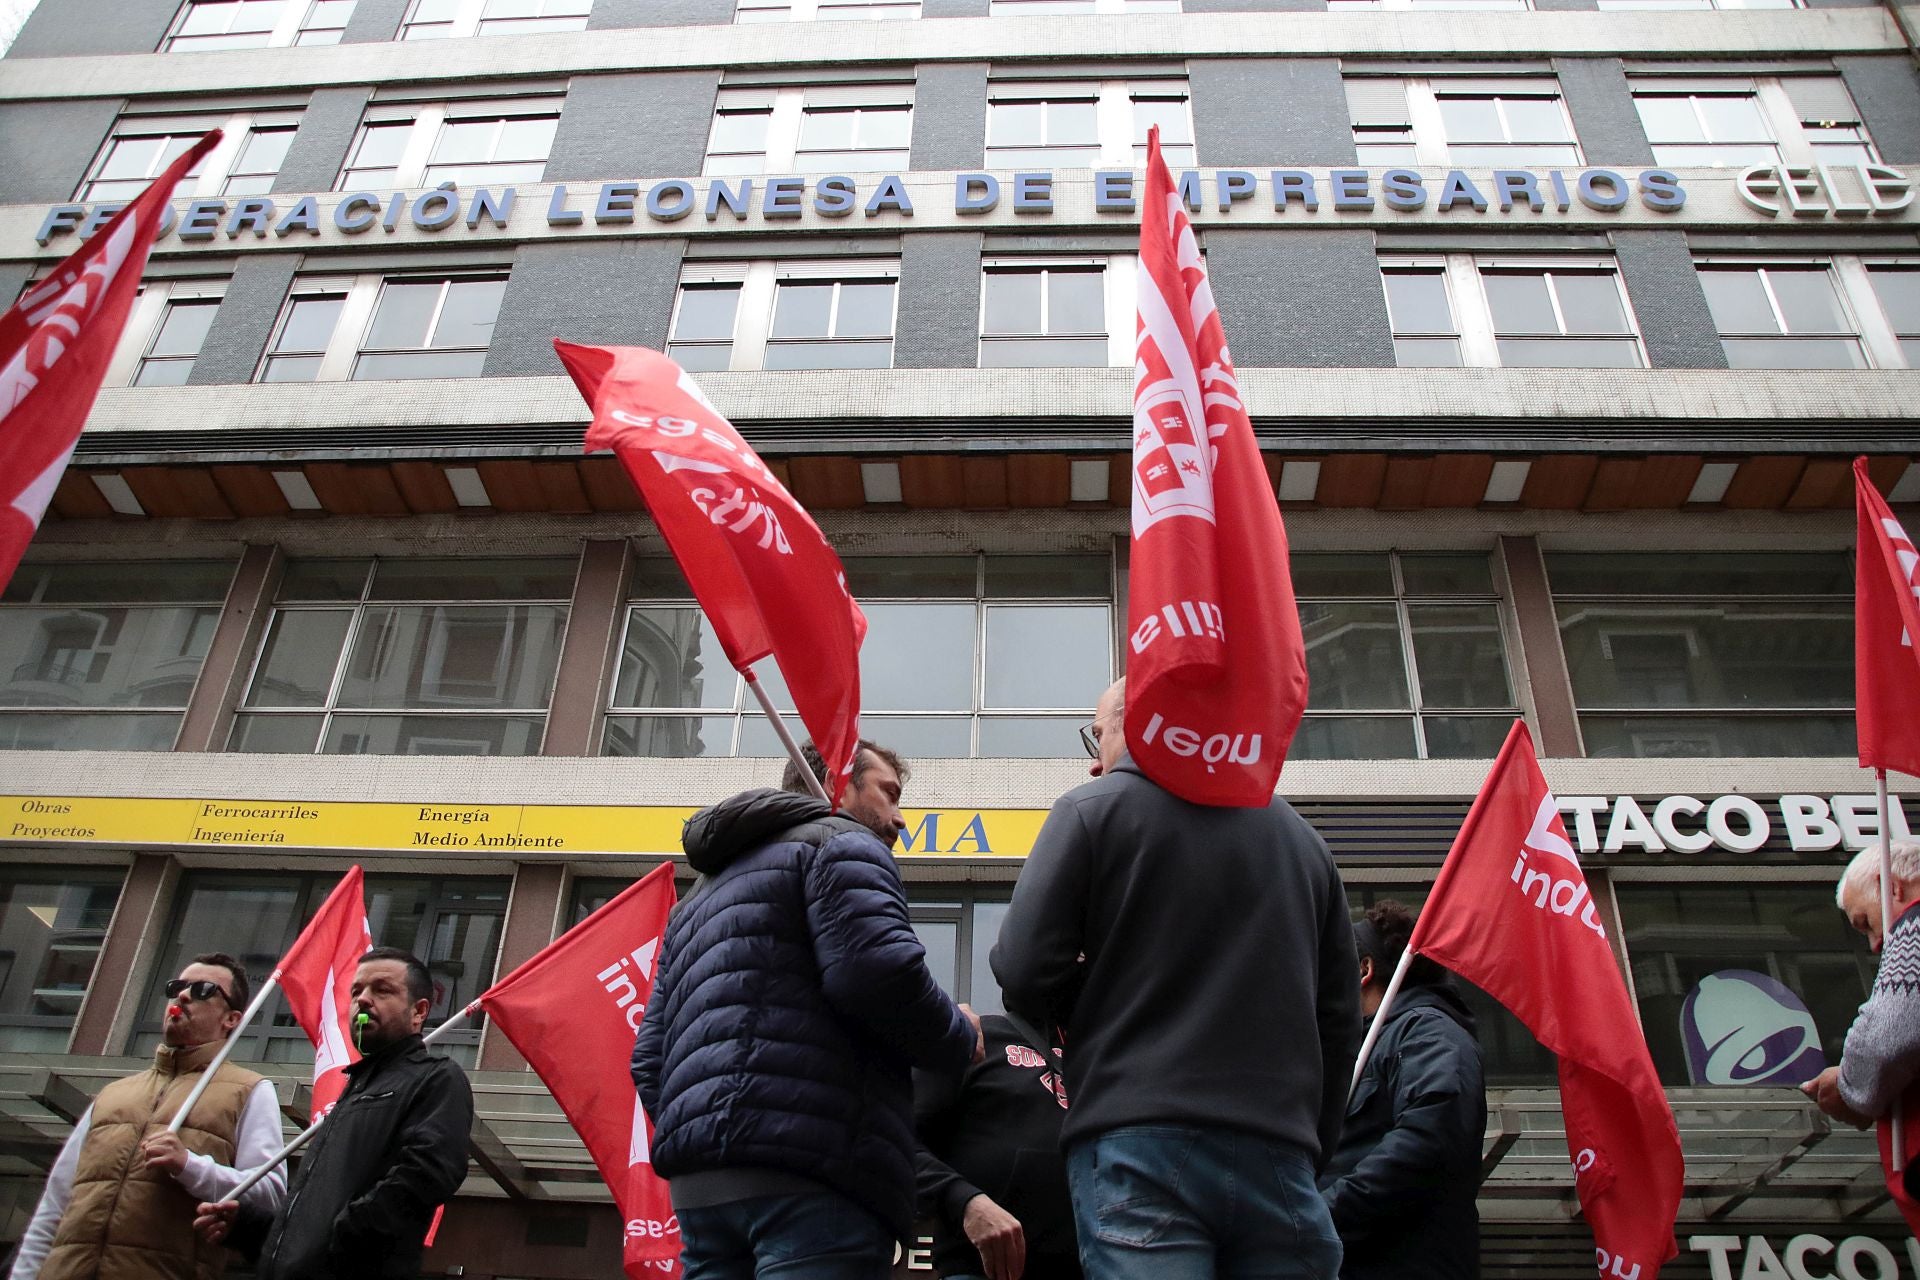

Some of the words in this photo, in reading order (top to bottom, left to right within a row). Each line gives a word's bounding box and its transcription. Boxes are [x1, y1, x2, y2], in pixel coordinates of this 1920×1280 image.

[546, 175, 914, 227] LEONESA
[954, 172, 1054, 215] DE
[21, 800, 71, 814] Obras
[202, 804, 319, 820] Ferrocarriles
[417, 808, 490, 825] Energía
[1554, 795, 1771, 854] TACO
[11, 823, 96, 839] Proyectos
[193, 827, 285, 843] Ingeniería
[412, 832, 469, 847] Medio
[473, 833, 564, 848] Ambiente
